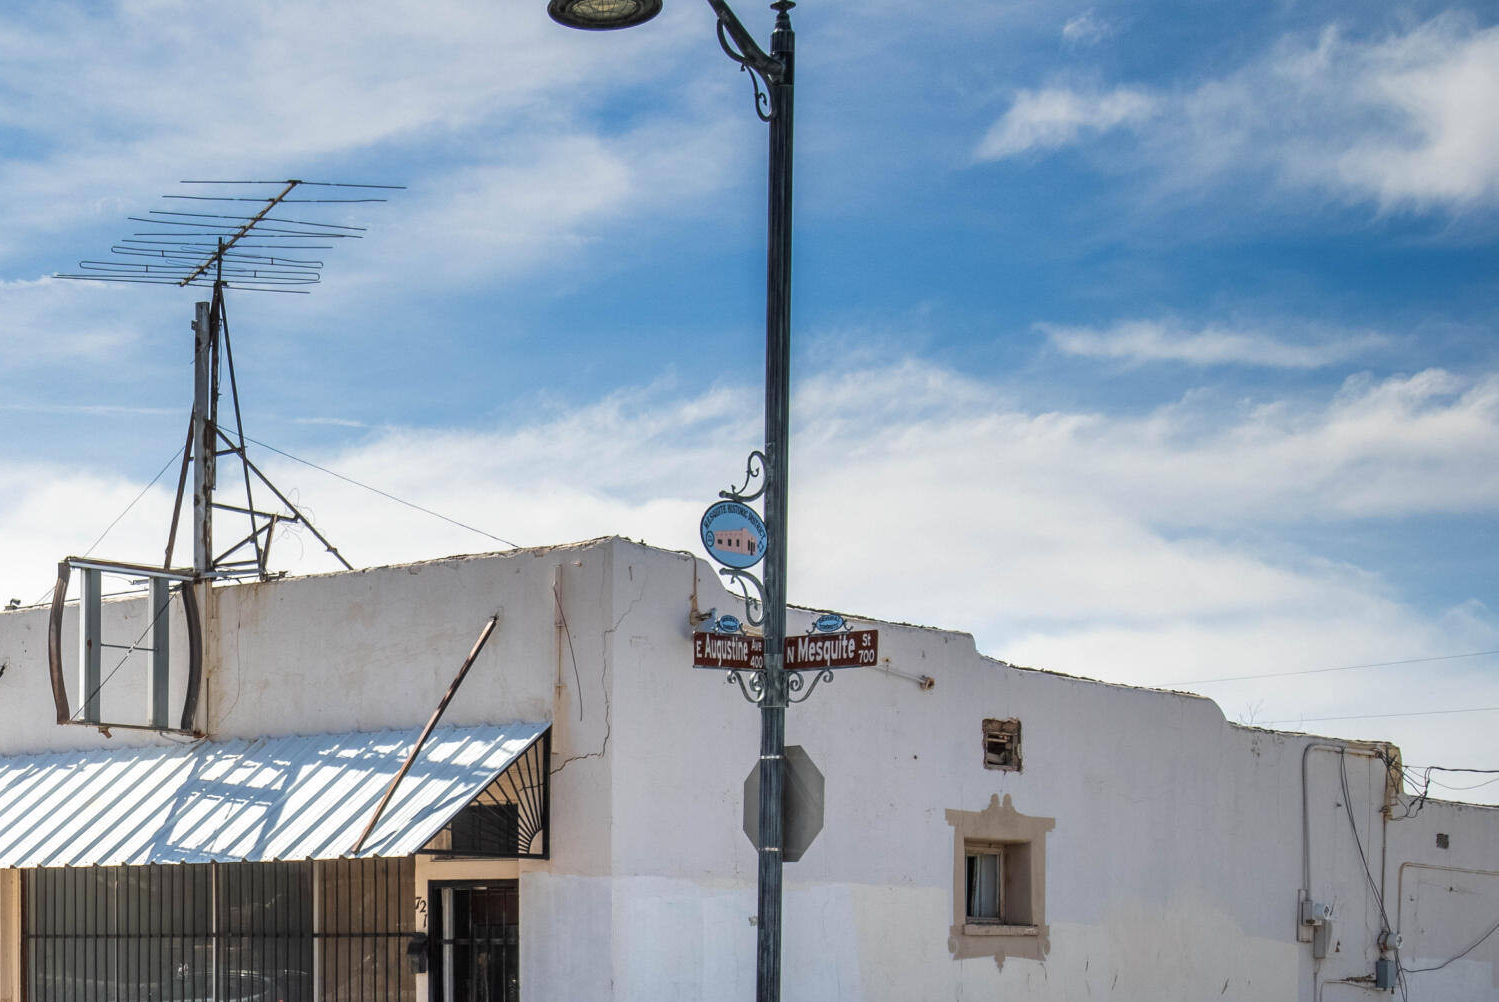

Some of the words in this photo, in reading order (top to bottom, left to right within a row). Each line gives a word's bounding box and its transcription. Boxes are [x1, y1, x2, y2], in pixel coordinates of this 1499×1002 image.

[696, 641, 702, 658] E
[704, 633, 749, 666] Augustine
[750, 639, 762, 652] Ave
[786, 646, 795, 663] N
[797, 635, 856, 667] Mesquite
[861, 633, 871, 646] St
[858, 650, 875, 663] 700
[750, 655, 763, 669] 400
